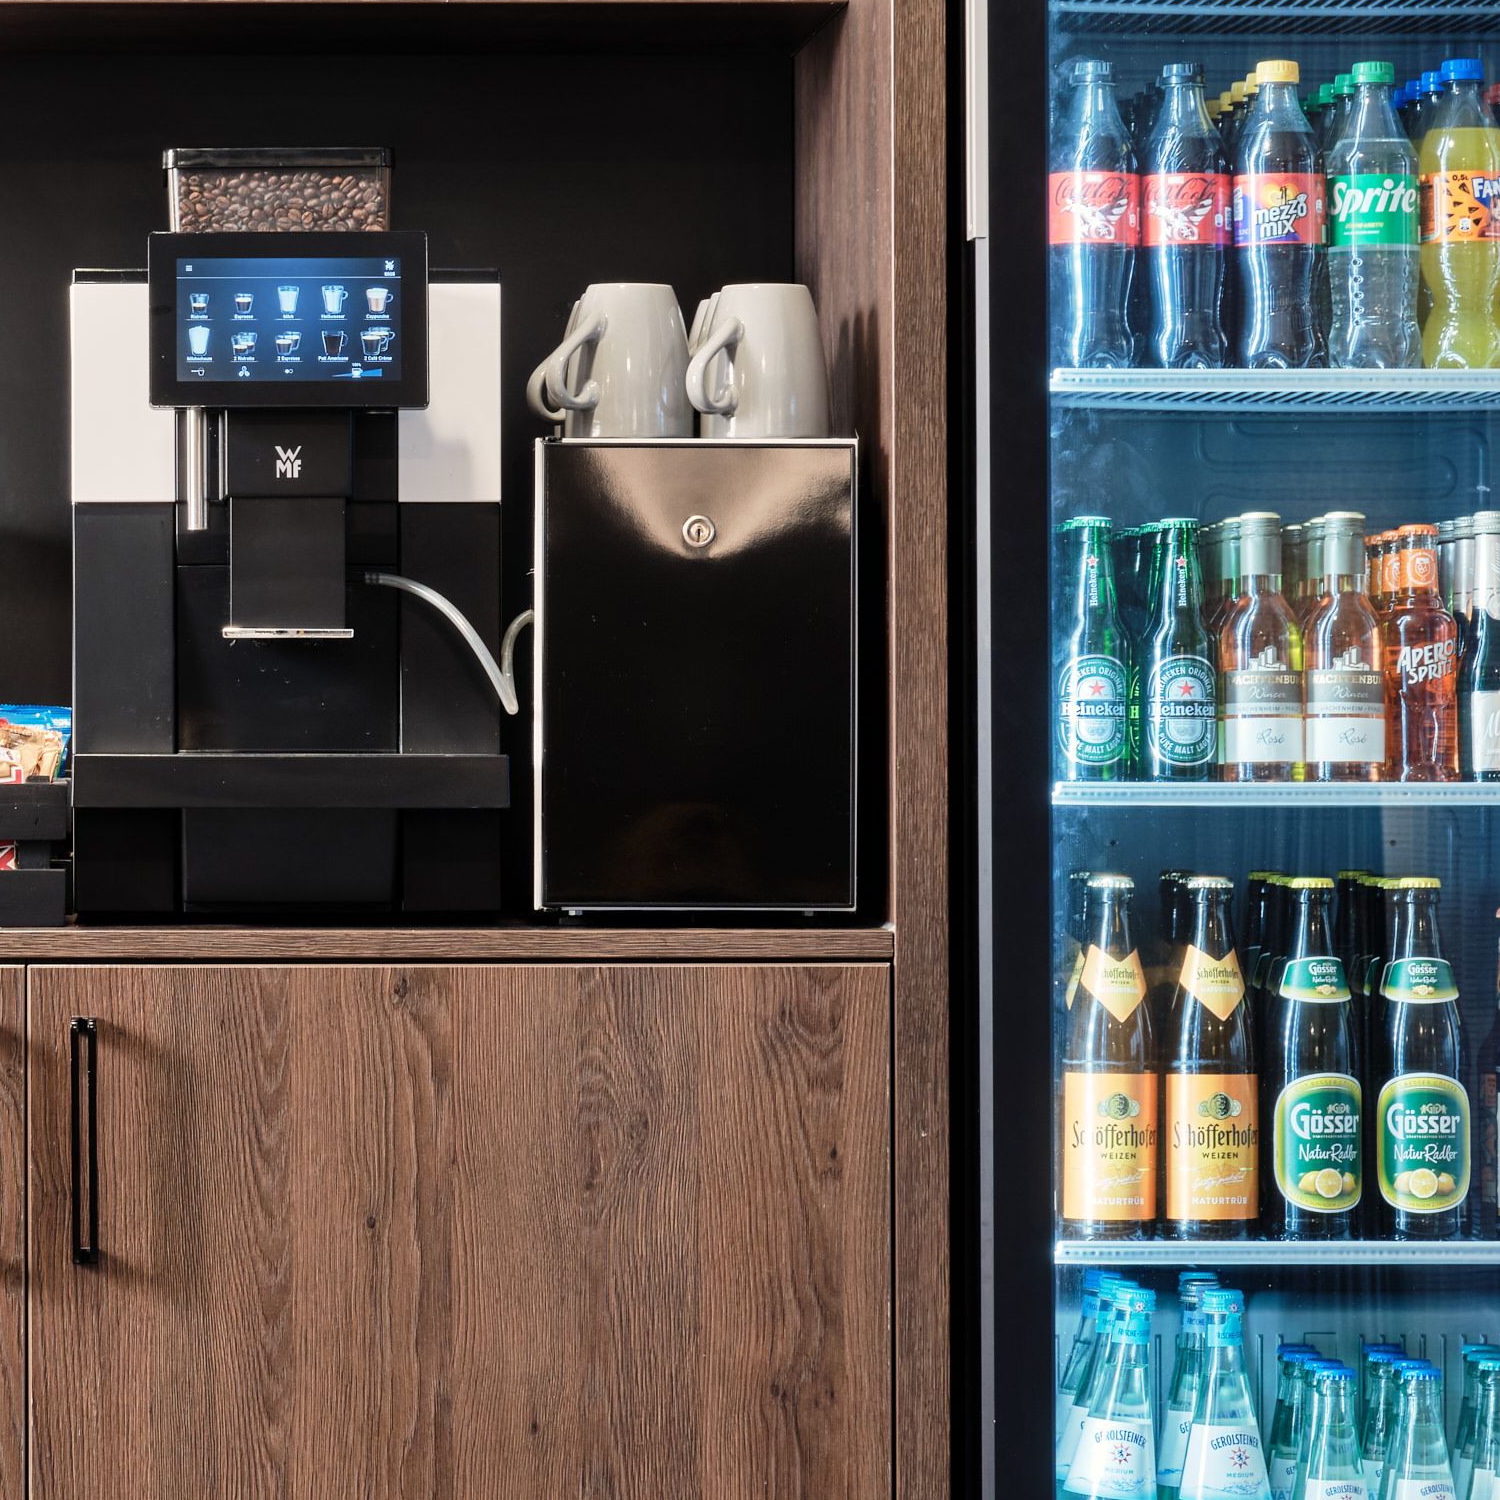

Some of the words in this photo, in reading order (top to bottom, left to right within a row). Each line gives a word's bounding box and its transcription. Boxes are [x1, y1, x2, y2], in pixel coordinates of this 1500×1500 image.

[1253, 194, 1308, 225] mezzo
[1330, 178, 1417, 222] Sprite
[1260, 217, 1298, 240] mix
[1089, 568, 1097, 607] Heineken
[1178, 568, 1186, 607] Heineken
[1062, 702, 1126, 717] Heineken
[1151, 702, 1215, 717] Heineken
[1308, 962, 1339, 976] Gösser
[1407, 962, 1439, 976] Gösser
[1290, 1102, 1360, 1140] Gösser
[1386, 1102, 1461, 1140] Gösser
[1099, 1152, 1137, 1160] WEIZEN
[1202, 1152, 1239, 1160] WEIZEN
[1210, 1433, 1259, 1450] GEROLSTEINER
